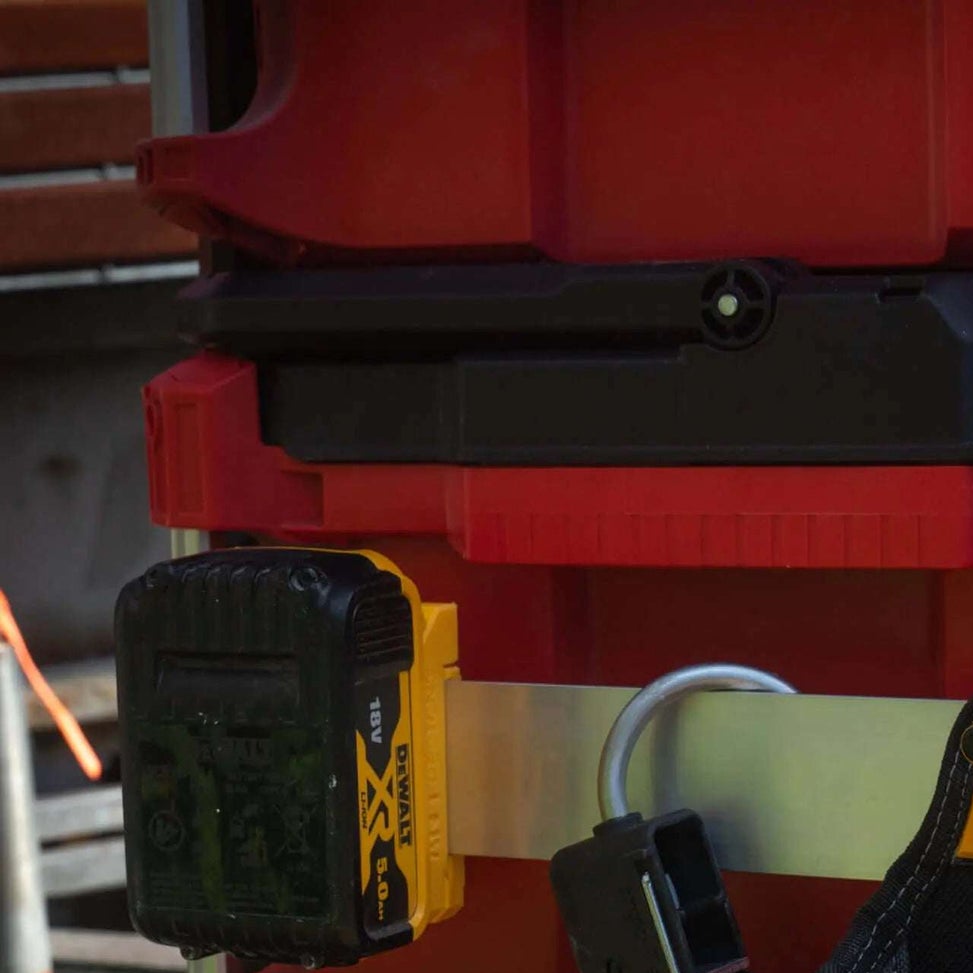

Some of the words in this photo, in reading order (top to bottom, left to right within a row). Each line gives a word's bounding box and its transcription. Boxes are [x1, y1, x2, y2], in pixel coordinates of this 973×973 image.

[369, 696, 383, 744] 18V
[366, 758, 396, 850] XR
[395, 743, 412, 848] DEWALT
